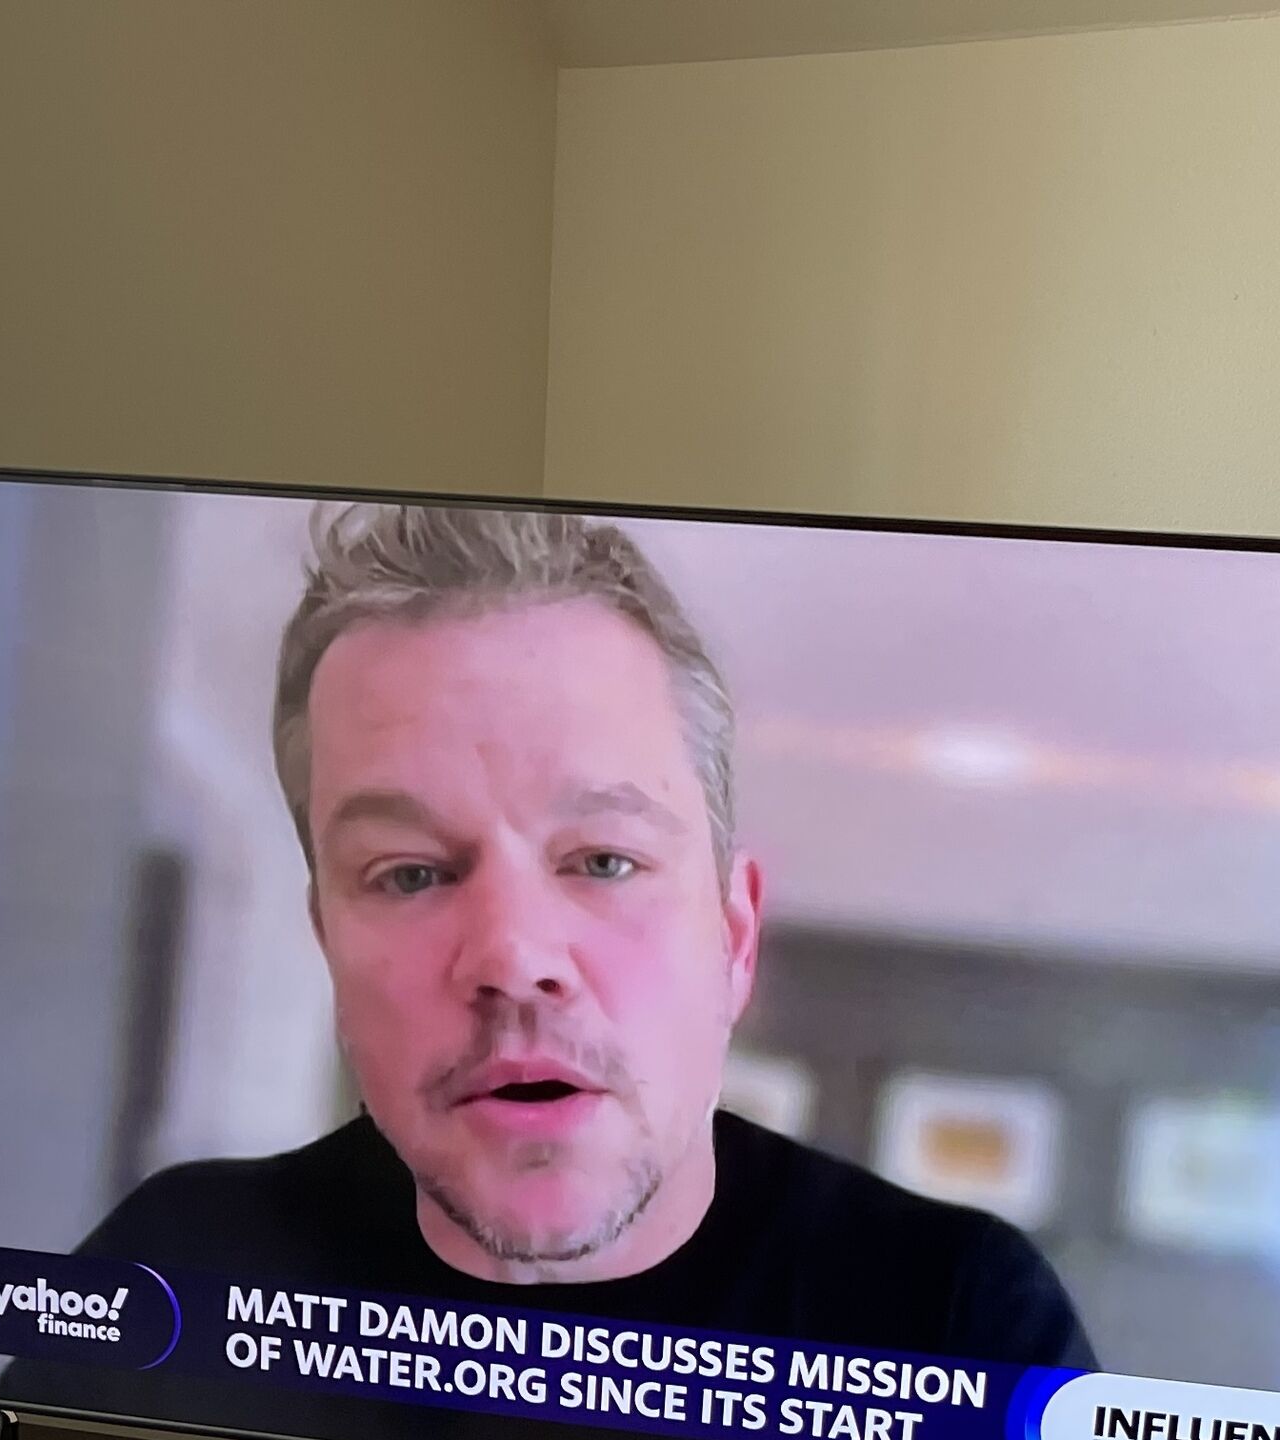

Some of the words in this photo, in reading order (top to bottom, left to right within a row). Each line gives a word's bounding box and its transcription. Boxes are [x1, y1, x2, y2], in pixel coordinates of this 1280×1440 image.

[37, 1312, 121, 1342] finance
[227, 1285, 348, 1334] MATT
[359, 1300, 527, 1355] DAMON
[541, 1322, 774, 1385] DISCUSSES
[788, 1350, 987, 1409] MISSION
[225, 1332, 282, 1371] OF
[293, 1339, 547, 1404] WATER.ORG
[559, 1371, 688, 1422] SINCE
[701, 1388, 767, 1431] ITS
